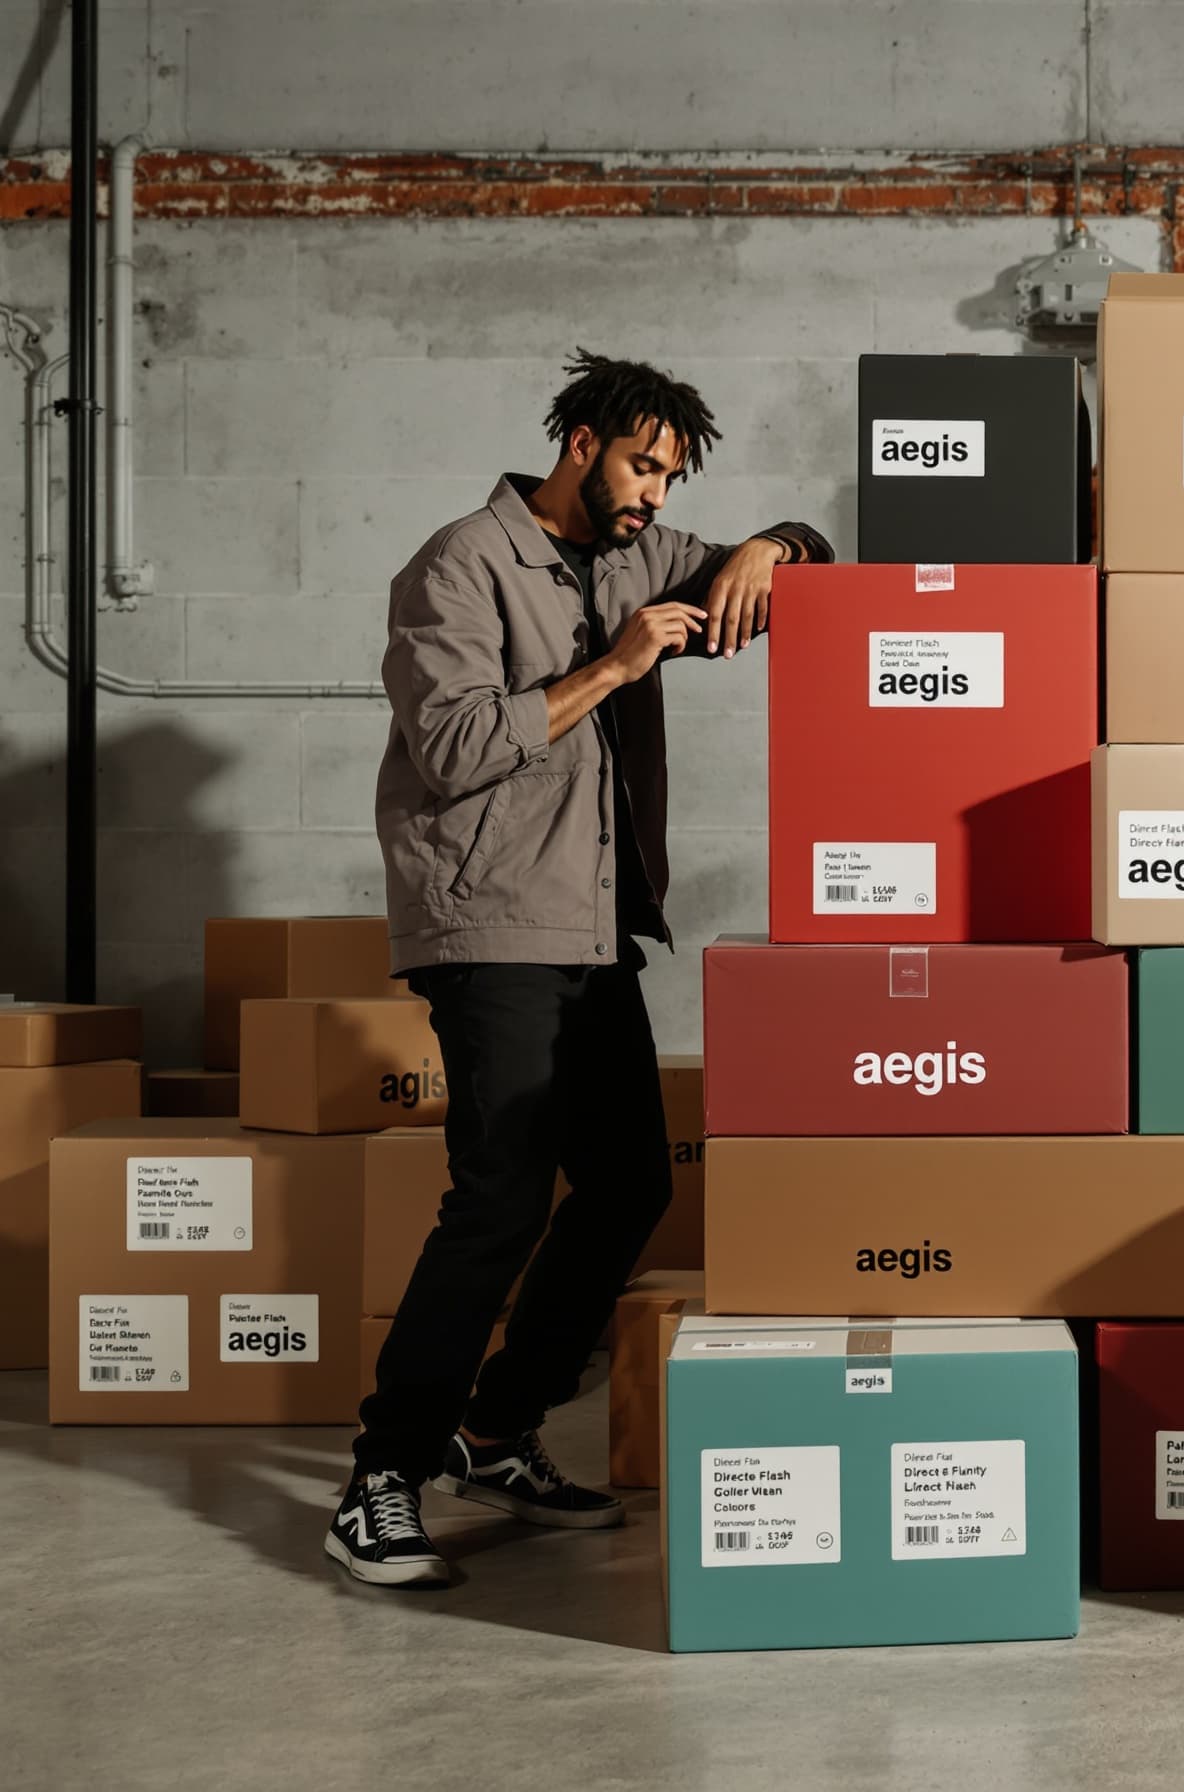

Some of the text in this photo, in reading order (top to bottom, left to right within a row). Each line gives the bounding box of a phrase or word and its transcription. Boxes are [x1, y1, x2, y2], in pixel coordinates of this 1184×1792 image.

[882, 434, 968, 468] aegis
[878, 666, 968, 701] aegis
[854, 1041, 986, 1095] aegis
[856, 1240, 952, 1278] aegis
[229, 1326, 306, 1356] aegis
[850, 1374, 886, 1389] aegis
